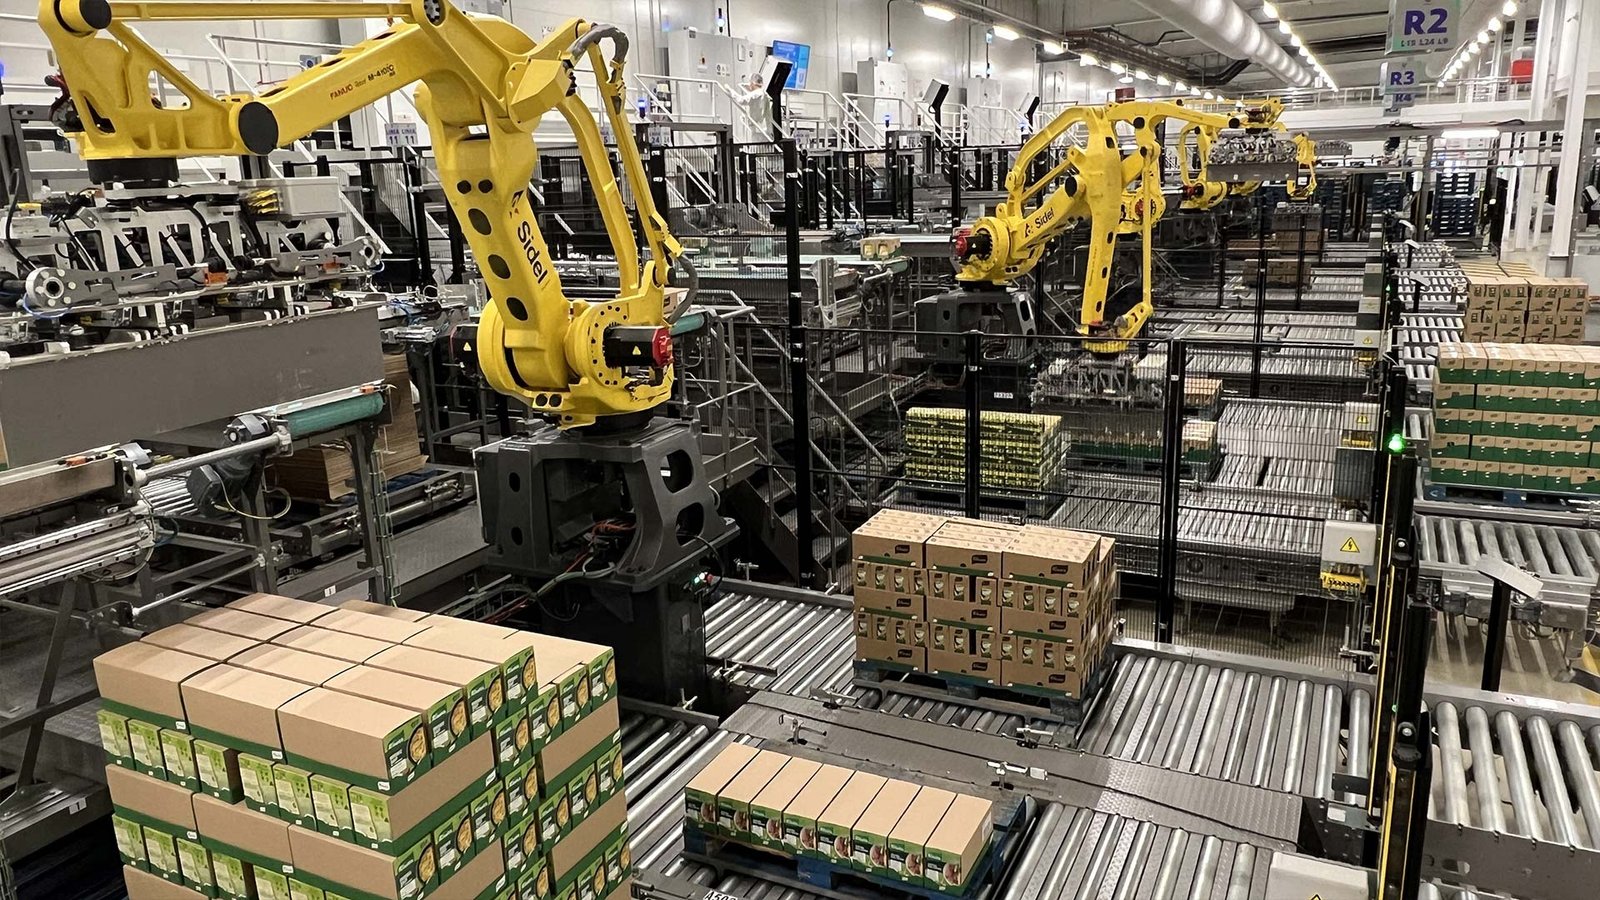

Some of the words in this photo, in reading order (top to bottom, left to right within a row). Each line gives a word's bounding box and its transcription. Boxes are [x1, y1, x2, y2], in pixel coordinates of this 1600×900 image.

[1404, 8, 1448, 36] R2
[1390, 71, 1414, 86] R3
[330, 83, 353, 100] FANUC
[389, 135, 398, 145] 11
[405, 135, 414, 145] 11
[1034, 207, 1055, 229] Sidel
[517, 221, 548, 284] Sidel
